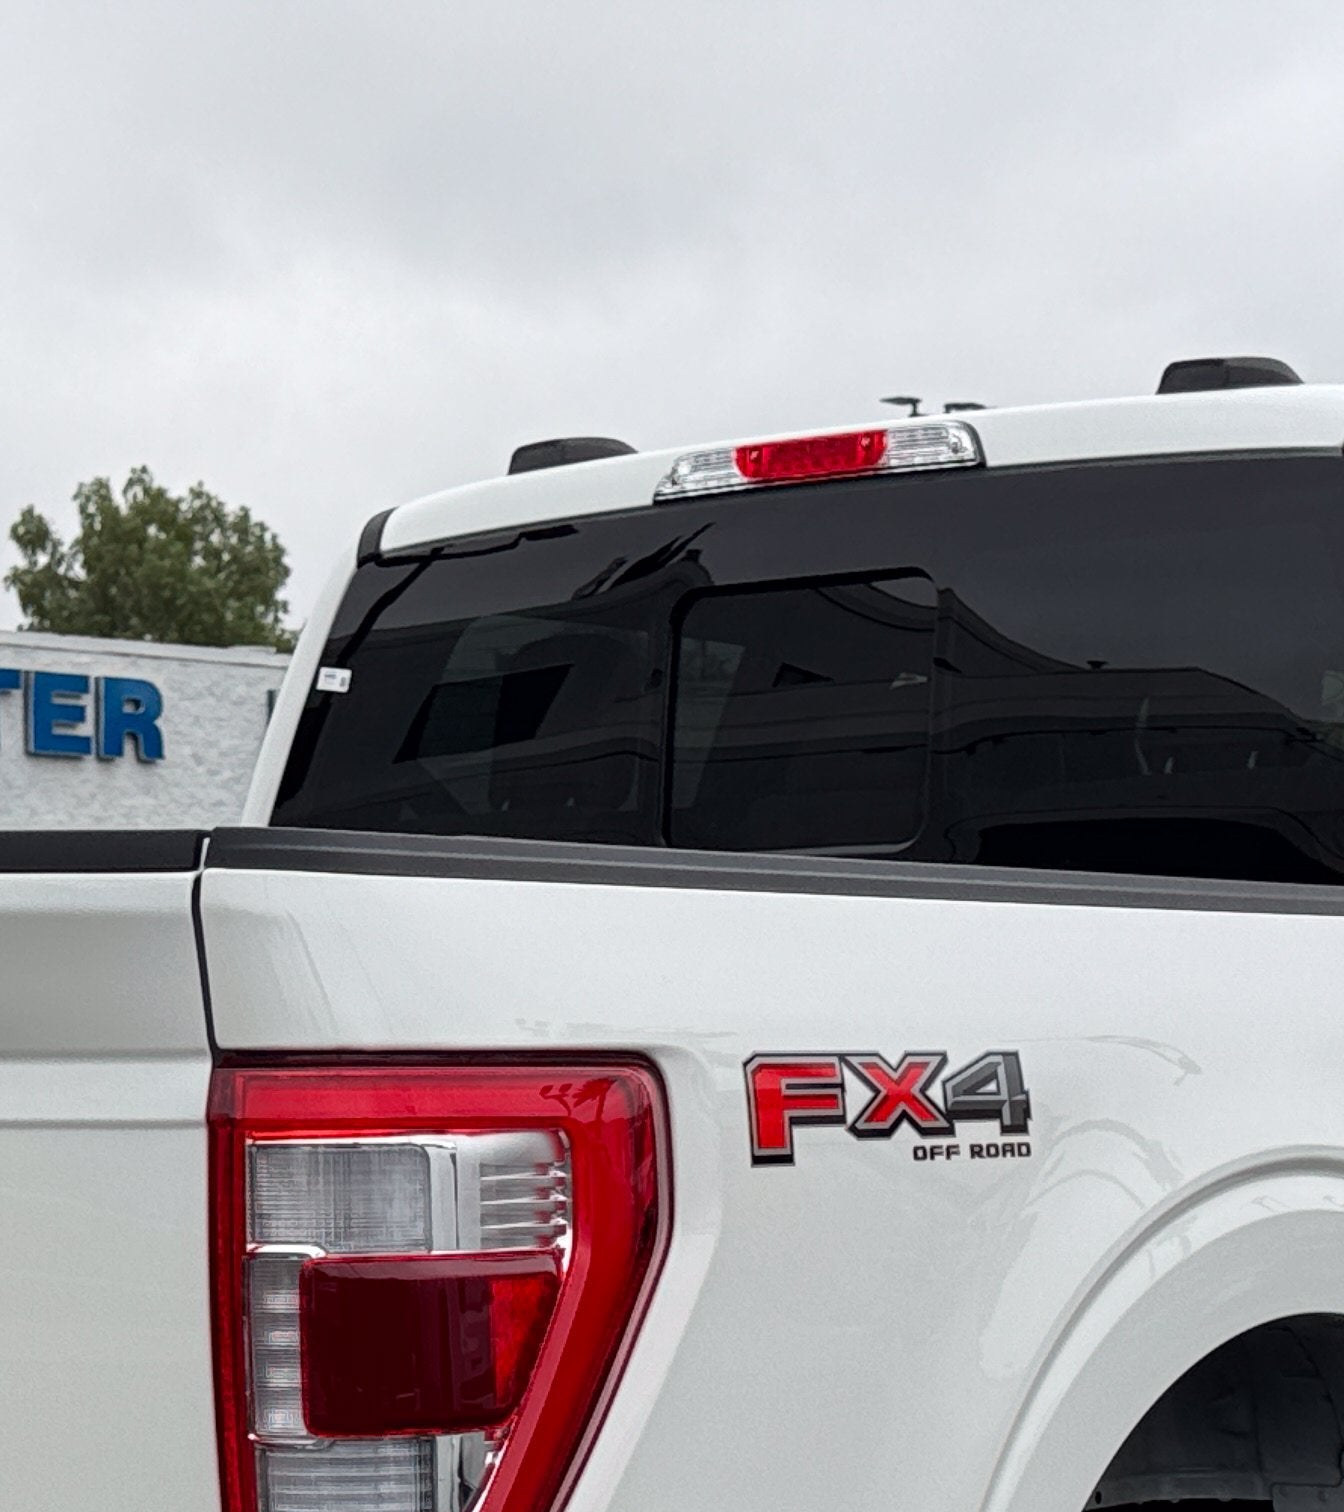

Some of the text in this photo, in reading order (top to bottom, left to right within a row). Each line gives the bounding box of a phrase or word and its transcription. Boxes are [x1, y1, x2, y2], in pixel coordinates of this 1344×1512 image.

[742, 1050, 1032, 1167] FX4
[913, 1142, 1032, 1162] OFF ROAD
